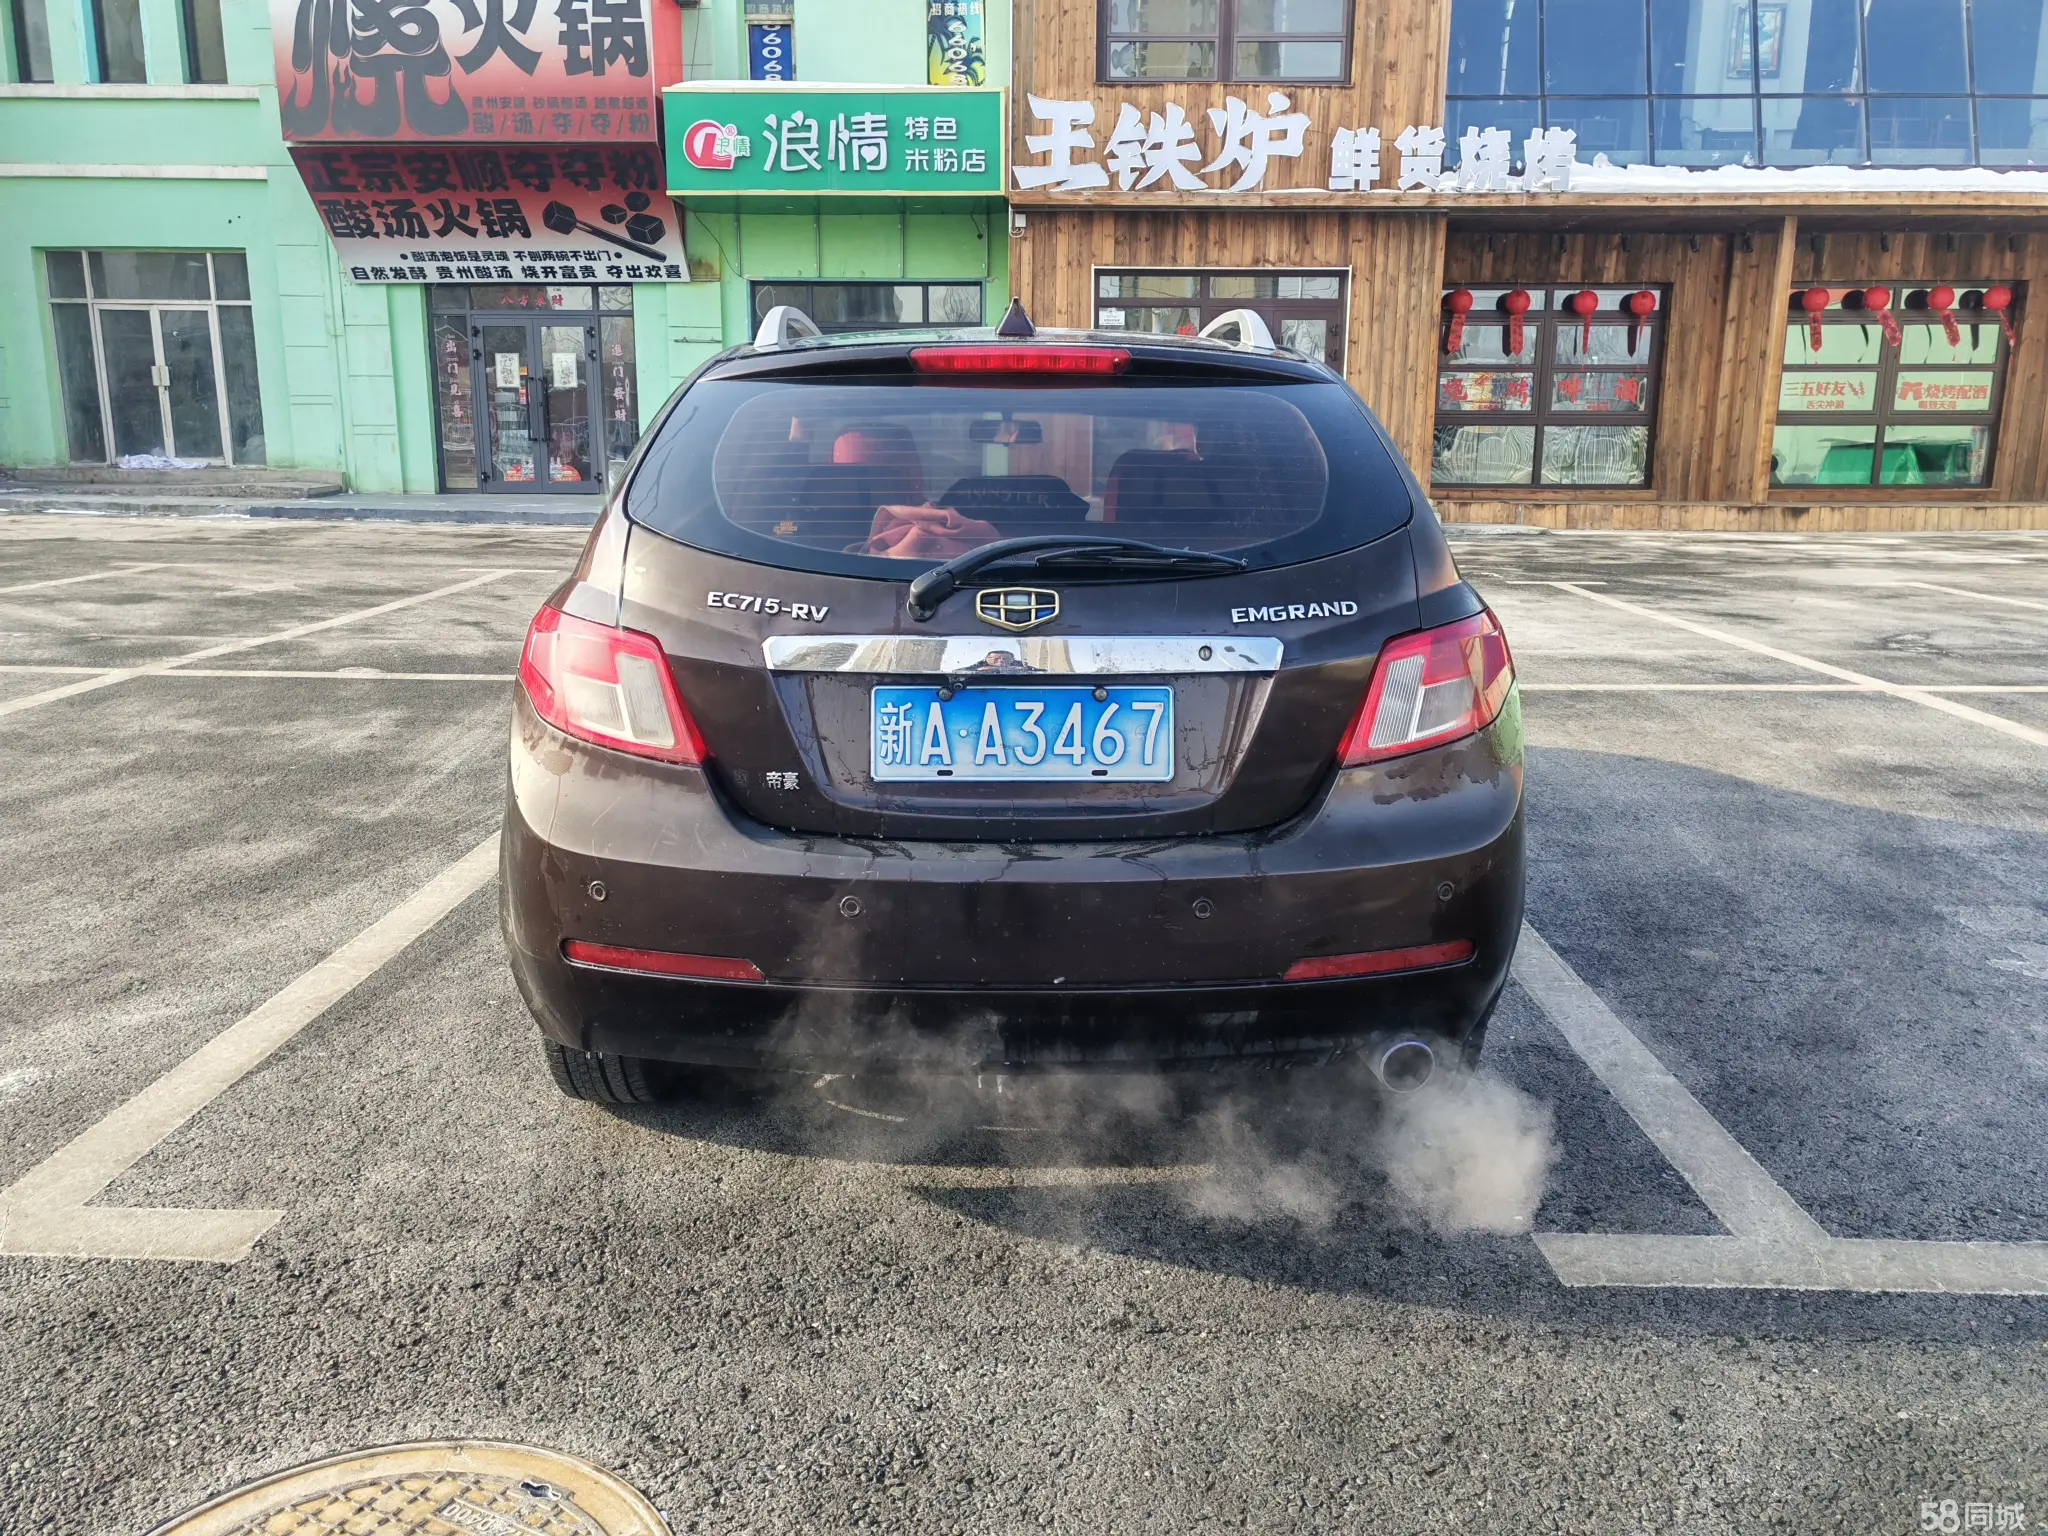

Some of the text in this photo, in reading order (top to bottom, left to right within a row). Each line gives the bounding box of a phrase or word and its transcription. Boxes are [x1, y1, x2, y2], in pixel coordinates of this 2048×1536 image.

[905, 117, 957, 140] 特色
[763, 110, 889, 172] 浪情
[1013, 92, 1577, 191] 王铁炉 鲜货烧烤
[302, 149, 660, 194] 正宗安顺夺夺粉
[905, 149, 986, 172] 米粉店
[323, 198, 532, 239] 酸汤火锅
[410, 251, 510, 262] 酸汤泡饭是灵魂
[350, 264, 682, 280] 自然发酵 贵州酸汤 烧开富贵 夺出欢喜
[1784, 381, 1847, 398] 三五好友
[1925, 384, 1989, 400] 烧烤配酒
[707, 591, 830, 621] EC715-RV
[1231, 601, 1358, 623] EMGRAND
[879, 701, 1165, 766] 新A·A3467
[766, 771, 800, 790] 帝豪
